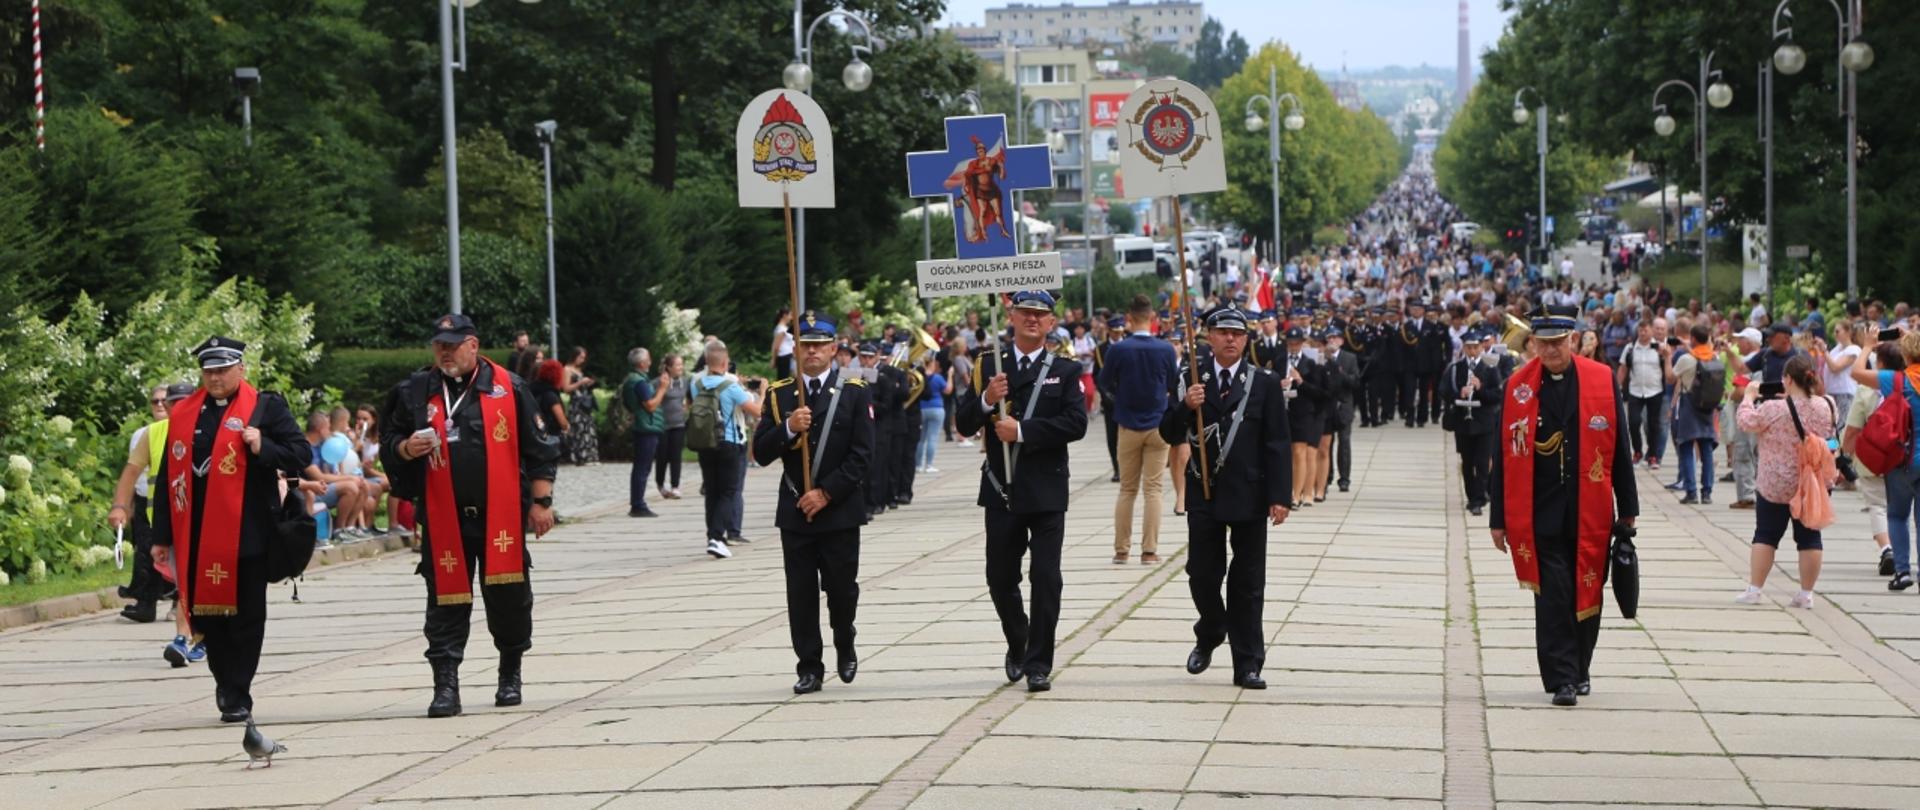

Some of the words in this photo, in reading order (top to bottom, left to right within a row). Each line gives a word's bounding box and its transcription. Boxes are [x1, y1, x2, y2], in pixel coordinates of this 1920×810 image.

[930, 262, 1009, 276] OGÓLNOPOLSKA
[1012, 260, 1046, 270] PIESZA
[924, 281, 992, 292] PIELGRZYMKA
[994, 274, 1055, 287] STRAŻAKÓW
